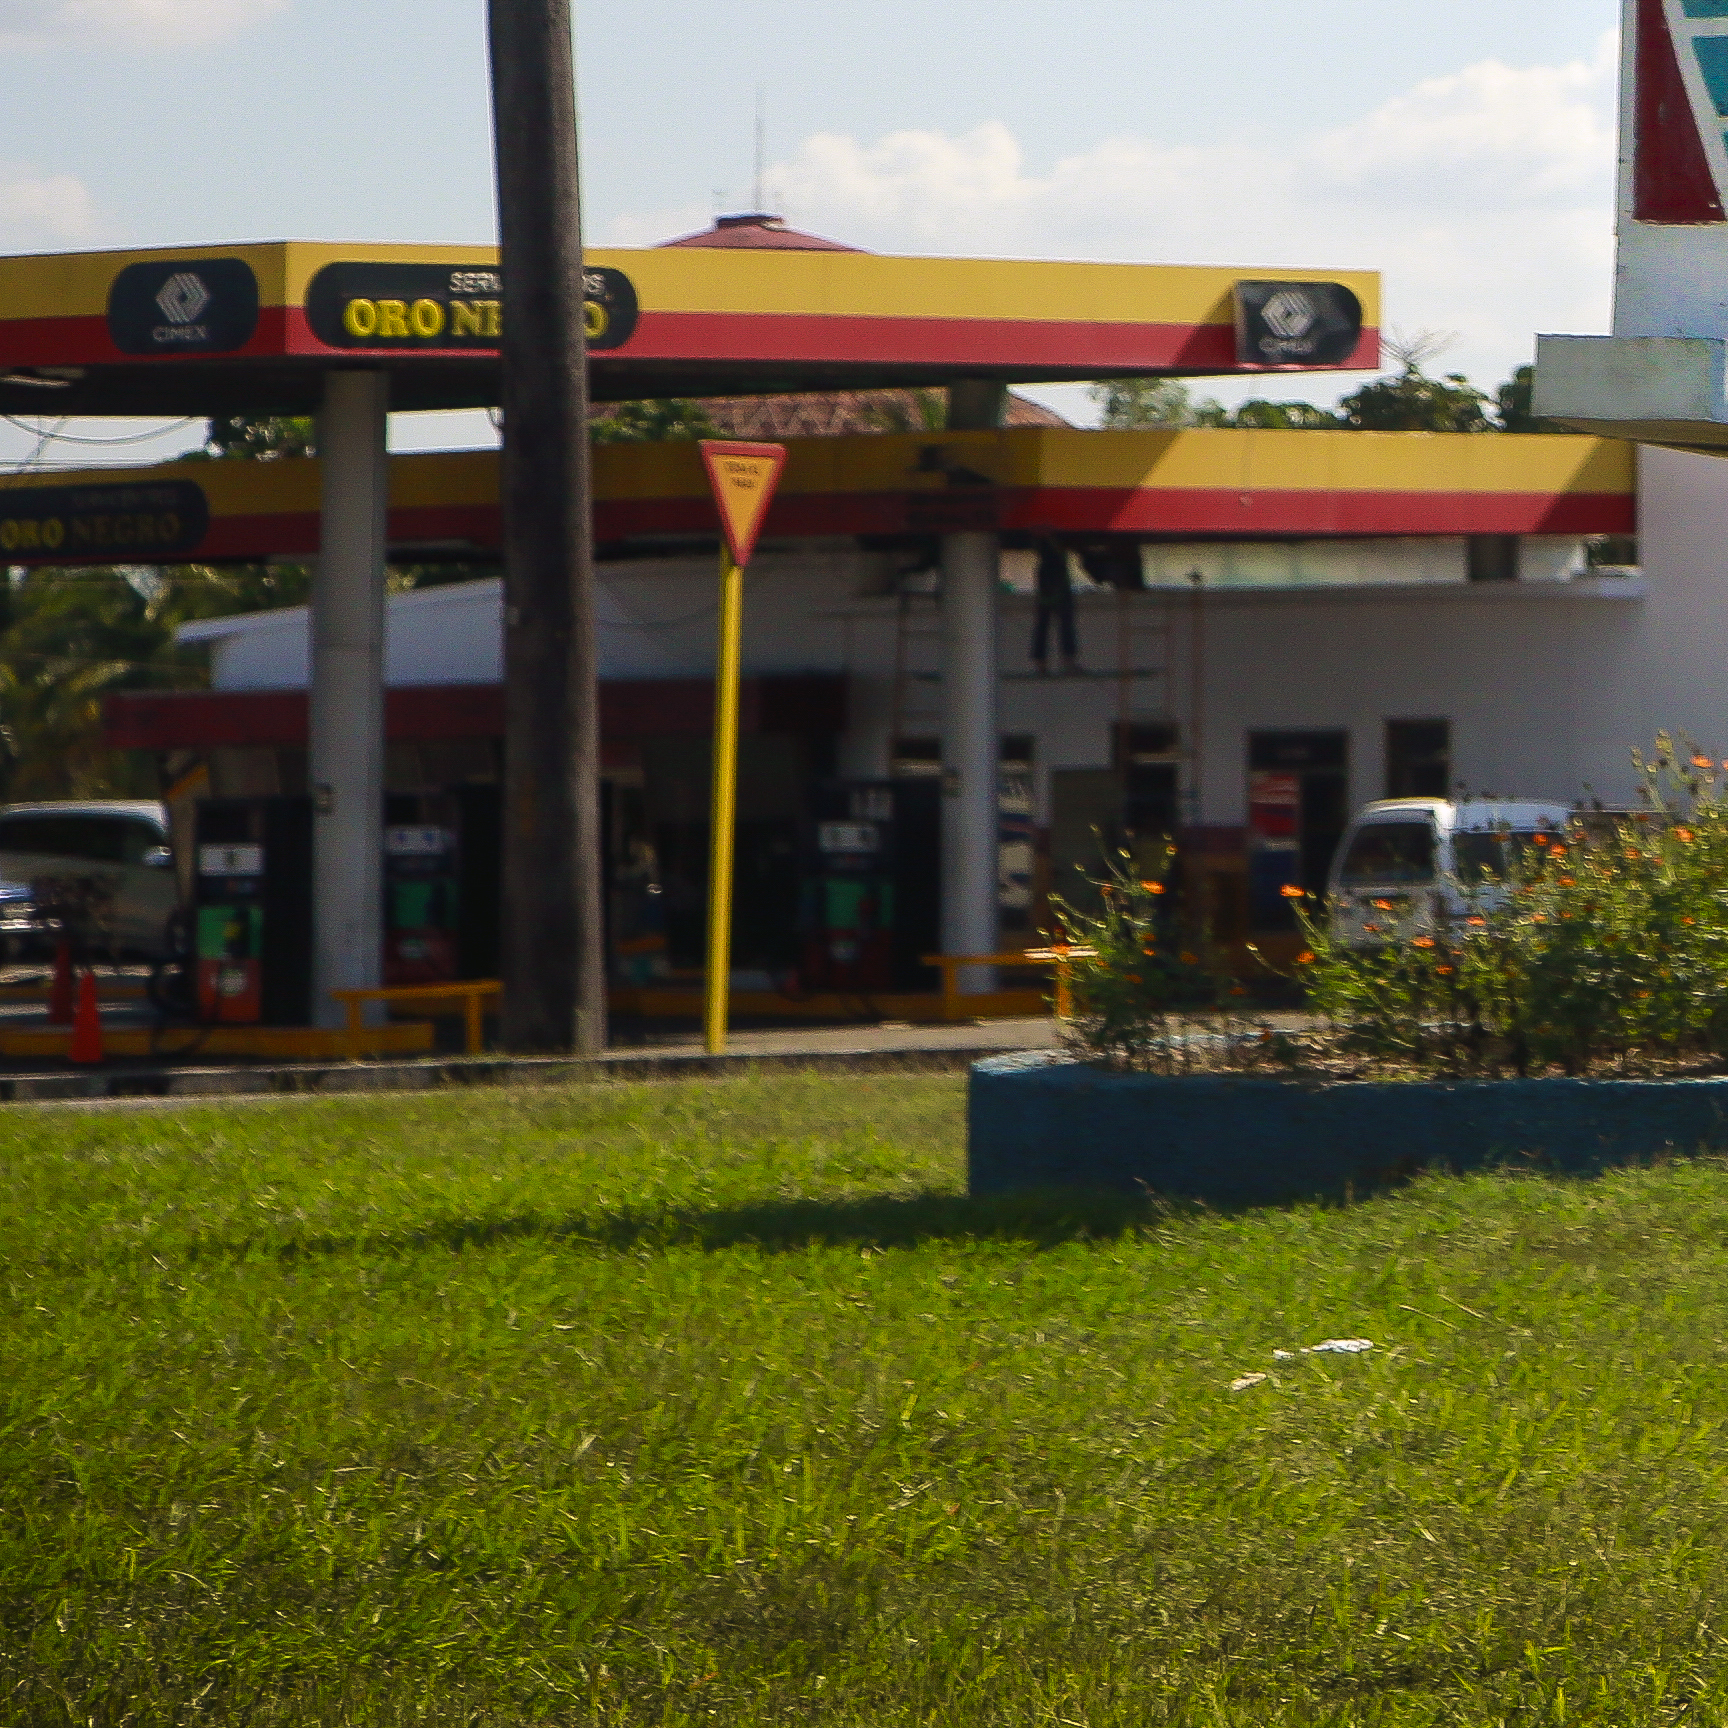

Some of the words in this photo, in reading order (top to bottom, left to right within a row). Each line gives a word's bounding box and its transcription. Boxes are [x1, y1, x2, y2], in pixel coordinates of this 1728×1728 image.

[151, 325, 208, 343] CIMEX
[343, 298, 445, 338] ORO
[450, 299, 609, 339] NEO
[71, 512, 181, 547] NEGRO
